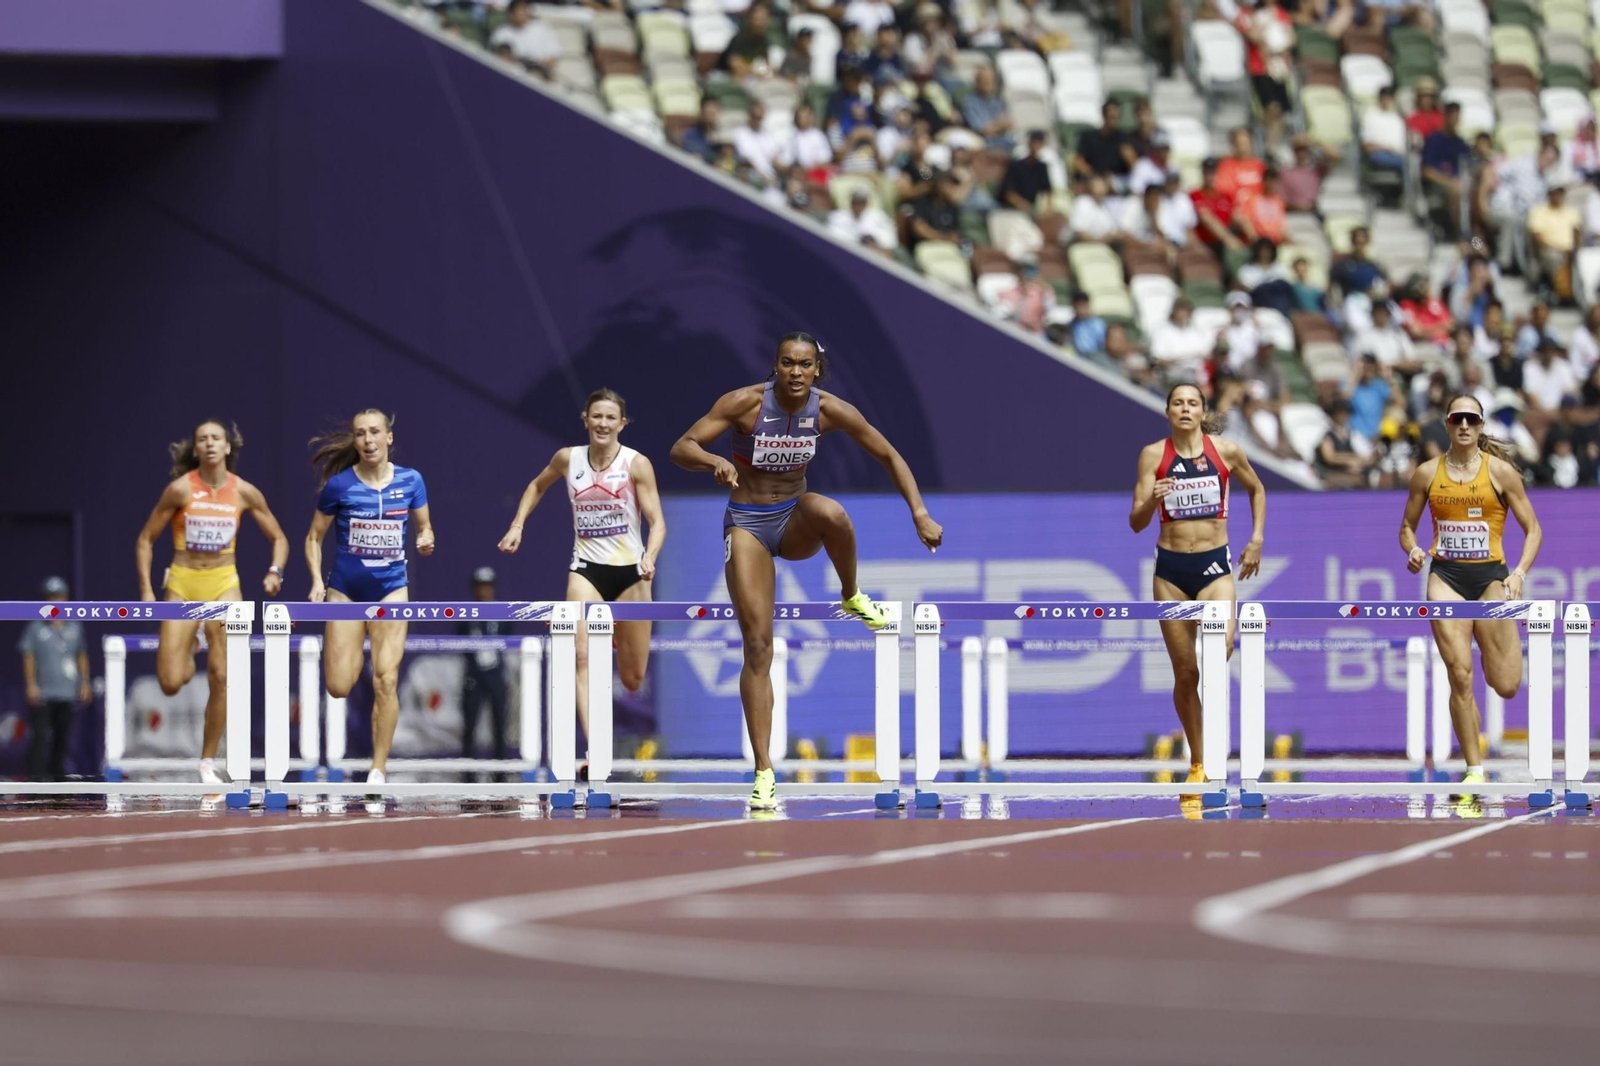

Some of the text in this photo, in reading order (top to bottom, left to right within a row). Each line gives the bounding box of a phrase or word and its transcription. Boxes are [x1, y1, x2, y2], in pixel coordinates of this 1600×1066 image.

[757, 440, 814, 449] HONDA
[757, 452, 811, 464] JONES
[1176, 493, 1209, 508] IUEL
[1437, 496, 1485, 506] GERMANY
[575, 504, 623, 513] HONDA
[188, 519, 234, 528] HONDA
[351, 522, 401, 531] HONDA
[1439, 524, 1488, 533] HONDA
[197, 530, 224, 542] FRA
[351, 532, 401, 547] HALONEN
[1440, 536, 1486, 549] KELETY
[227, 623, 249, 631] NISHI
[265, 623, 287, 631] NISHI
[552, 623, 574, 631] NISHI
[588, 623, 610, 631] NISHI
[826, 558, 1297, 692] TDK
[916, 623, 938, 631] NISHI
[1203, 622, 1225, 630] NISHI
[1241, 622, 1263, 630] NISHI
[1529, 622, 1551, 630] NISHI
[1566, 622, 1588, 630] NISHI
